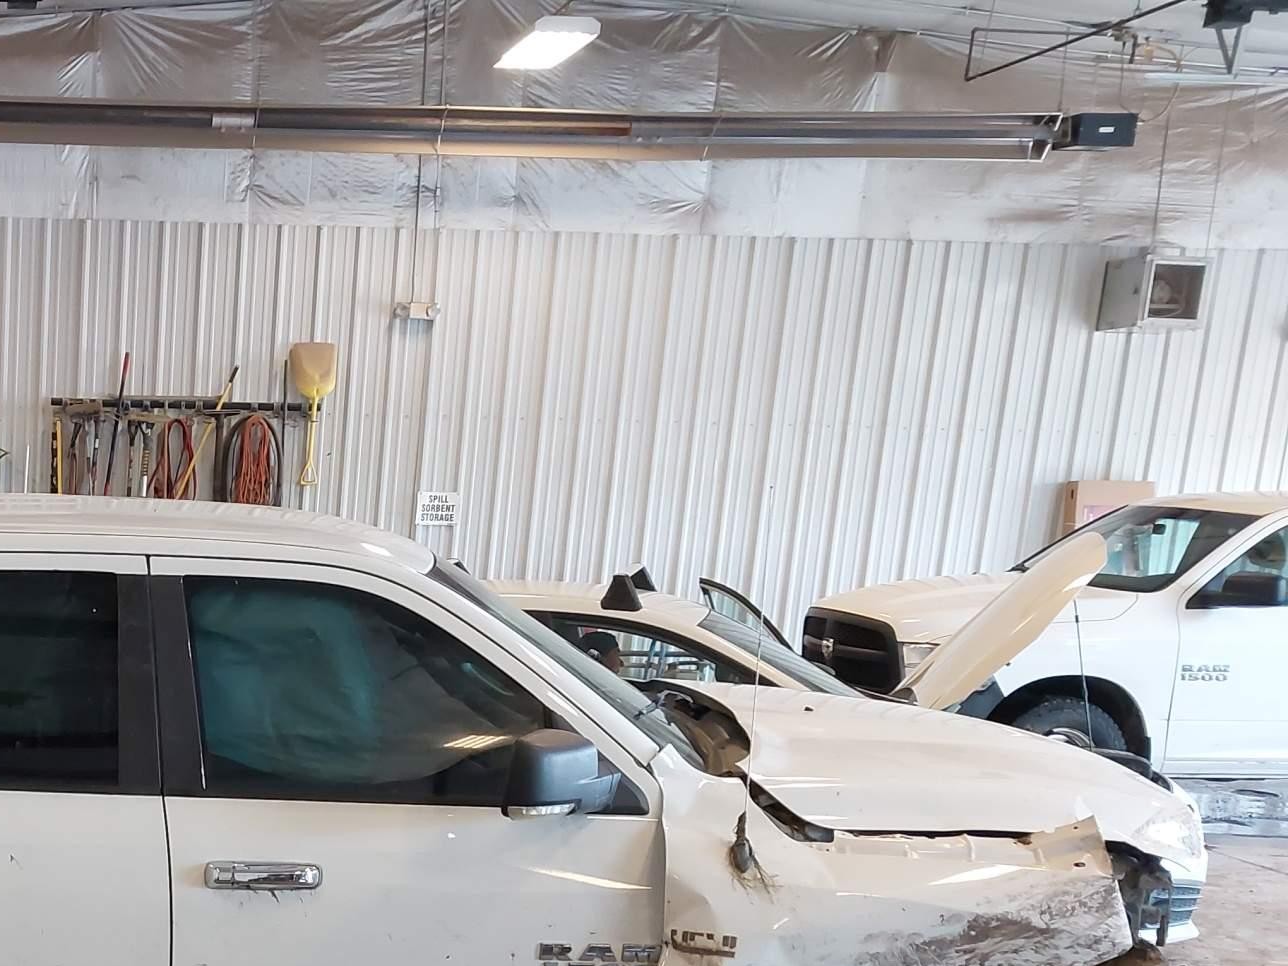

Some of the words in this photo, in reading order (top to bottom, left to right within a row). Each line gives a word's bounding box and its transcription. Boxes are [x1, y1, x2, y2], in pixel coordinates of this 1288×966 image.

[428, 494, 449, 504] SPILL
[421, 504, 456, 513] SORBENT
[420, 513, 455, 522] STORAGE
[1181, 664, 1231, 673] RAM
[1180, 673, 1229, 682] 1500
[538, 942, 663, 962] RAM
